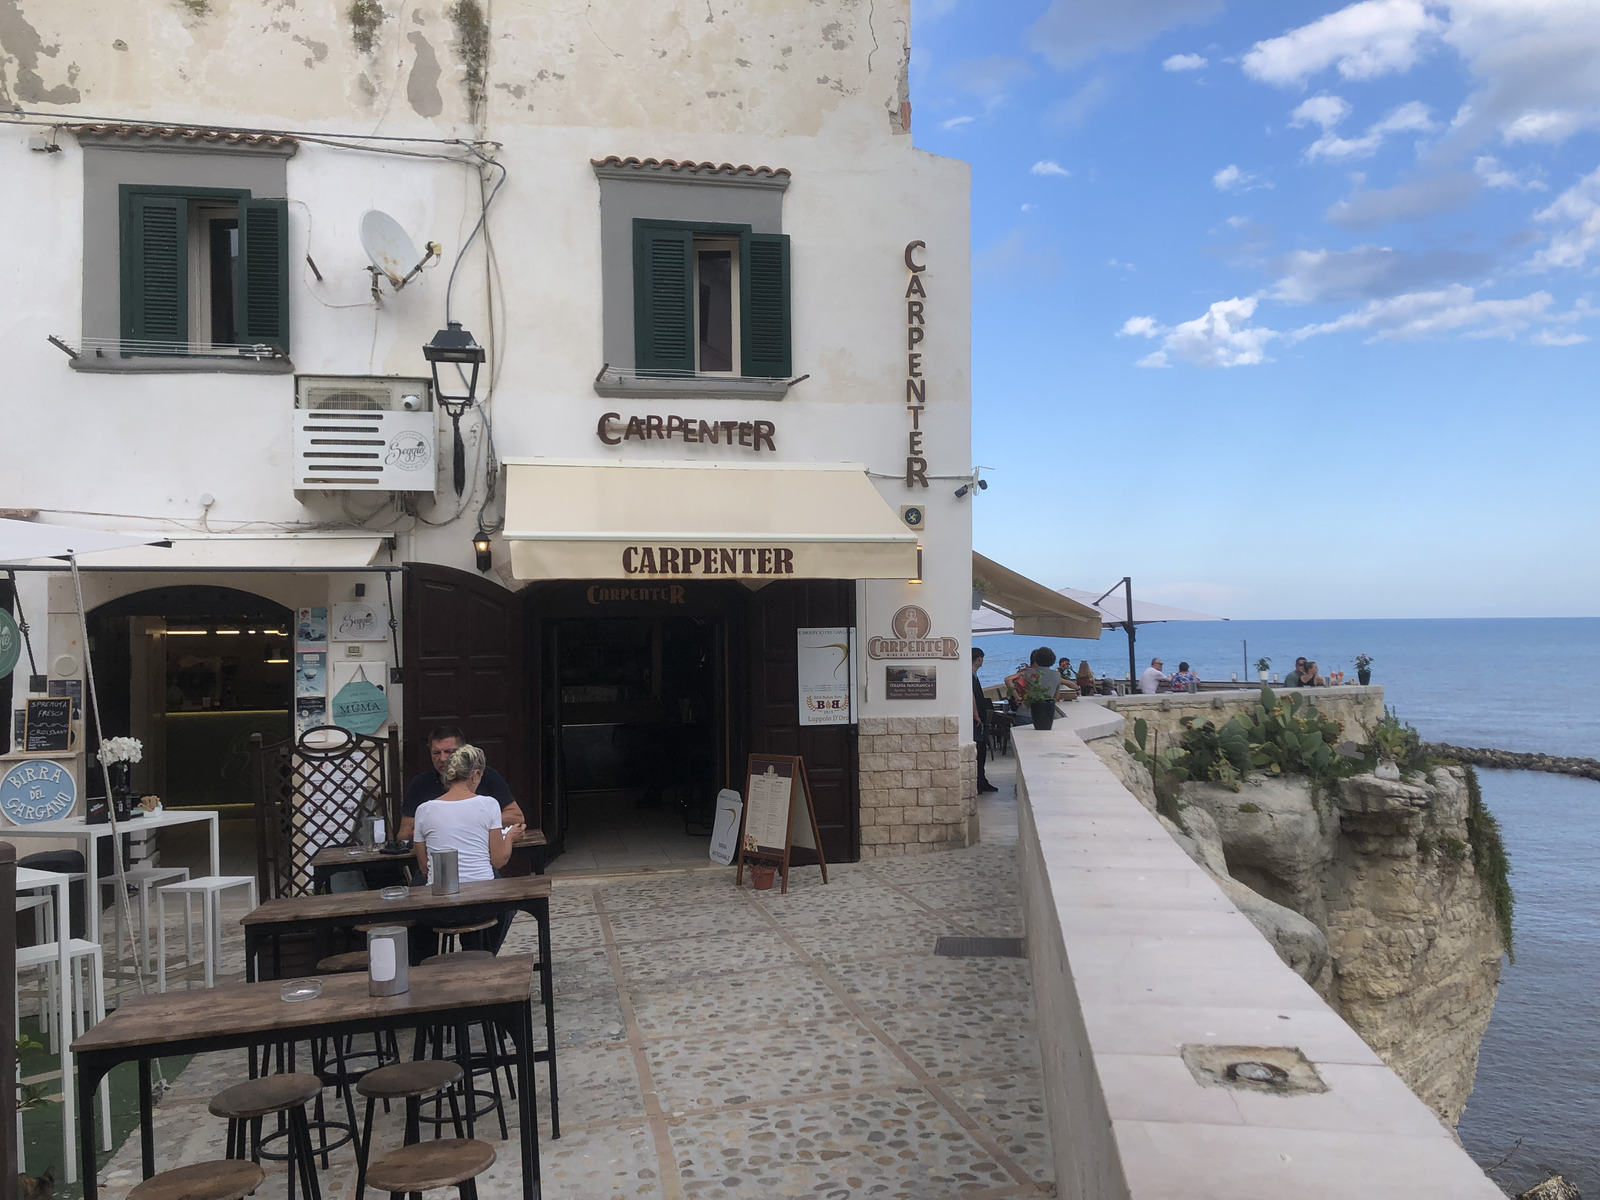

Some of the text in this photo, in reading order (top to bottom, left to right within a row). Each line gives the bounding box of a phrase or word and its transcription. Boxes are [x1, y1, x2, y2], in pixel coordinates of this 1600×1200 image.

[904, 240, 928, 488] CARPENTER
[597, 412, 776, 451] CARPENTER
[385, 441, 426, 465] Seggio
[622, 546, 794, 574] CARPENTER
[587, 585, 685, 605] CARPENTER
[869, 638, 957, 657] CARPENTER
[339, 702, 380, 714] MUMA
[808, 715, 831, 723] Luppolo
[8, 768, 62, 788] BIRRA
[30, 789, 45, 800] DEL
[6, 792, 71, 819] GARGANO
